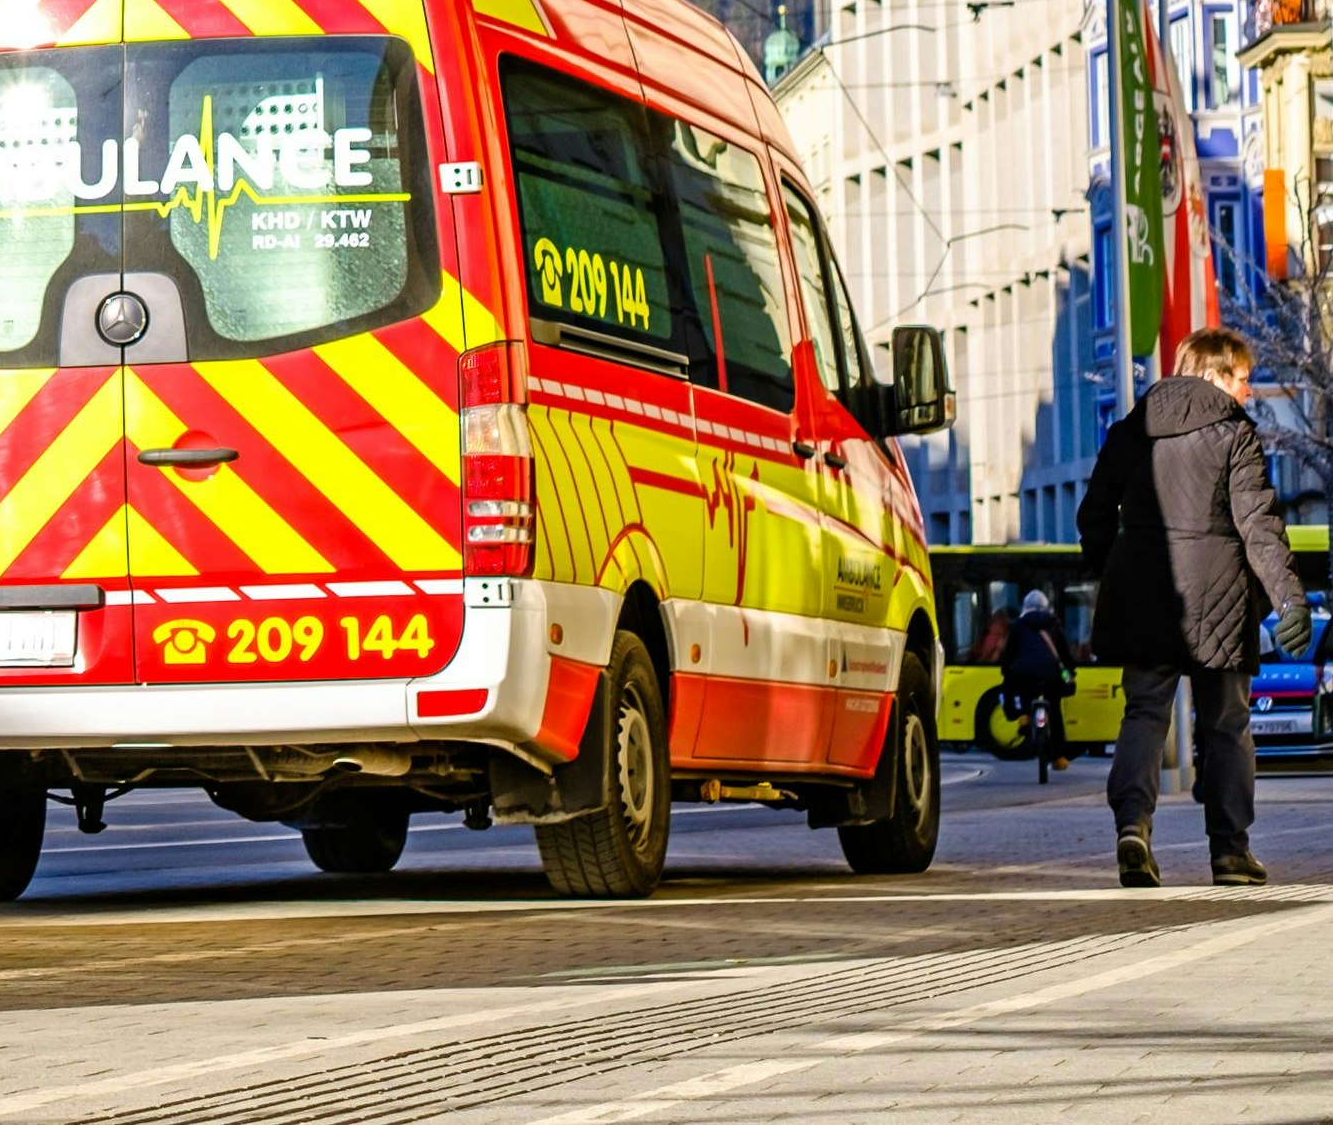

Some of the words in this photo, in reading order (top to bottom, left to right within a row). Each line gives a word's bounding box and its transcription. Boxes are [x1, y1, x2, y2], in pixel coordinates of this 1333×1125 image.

[251, 211, 301, 230] KHD
[321, 209, 372, 229] KTW
[314, 233, 370, 248] 29.462
[566, 247, 607, 318] 209
[610, 261, 650, 330] 144
[226, 617, 324, 664] 209
[340, 614, 435, 661] 144
